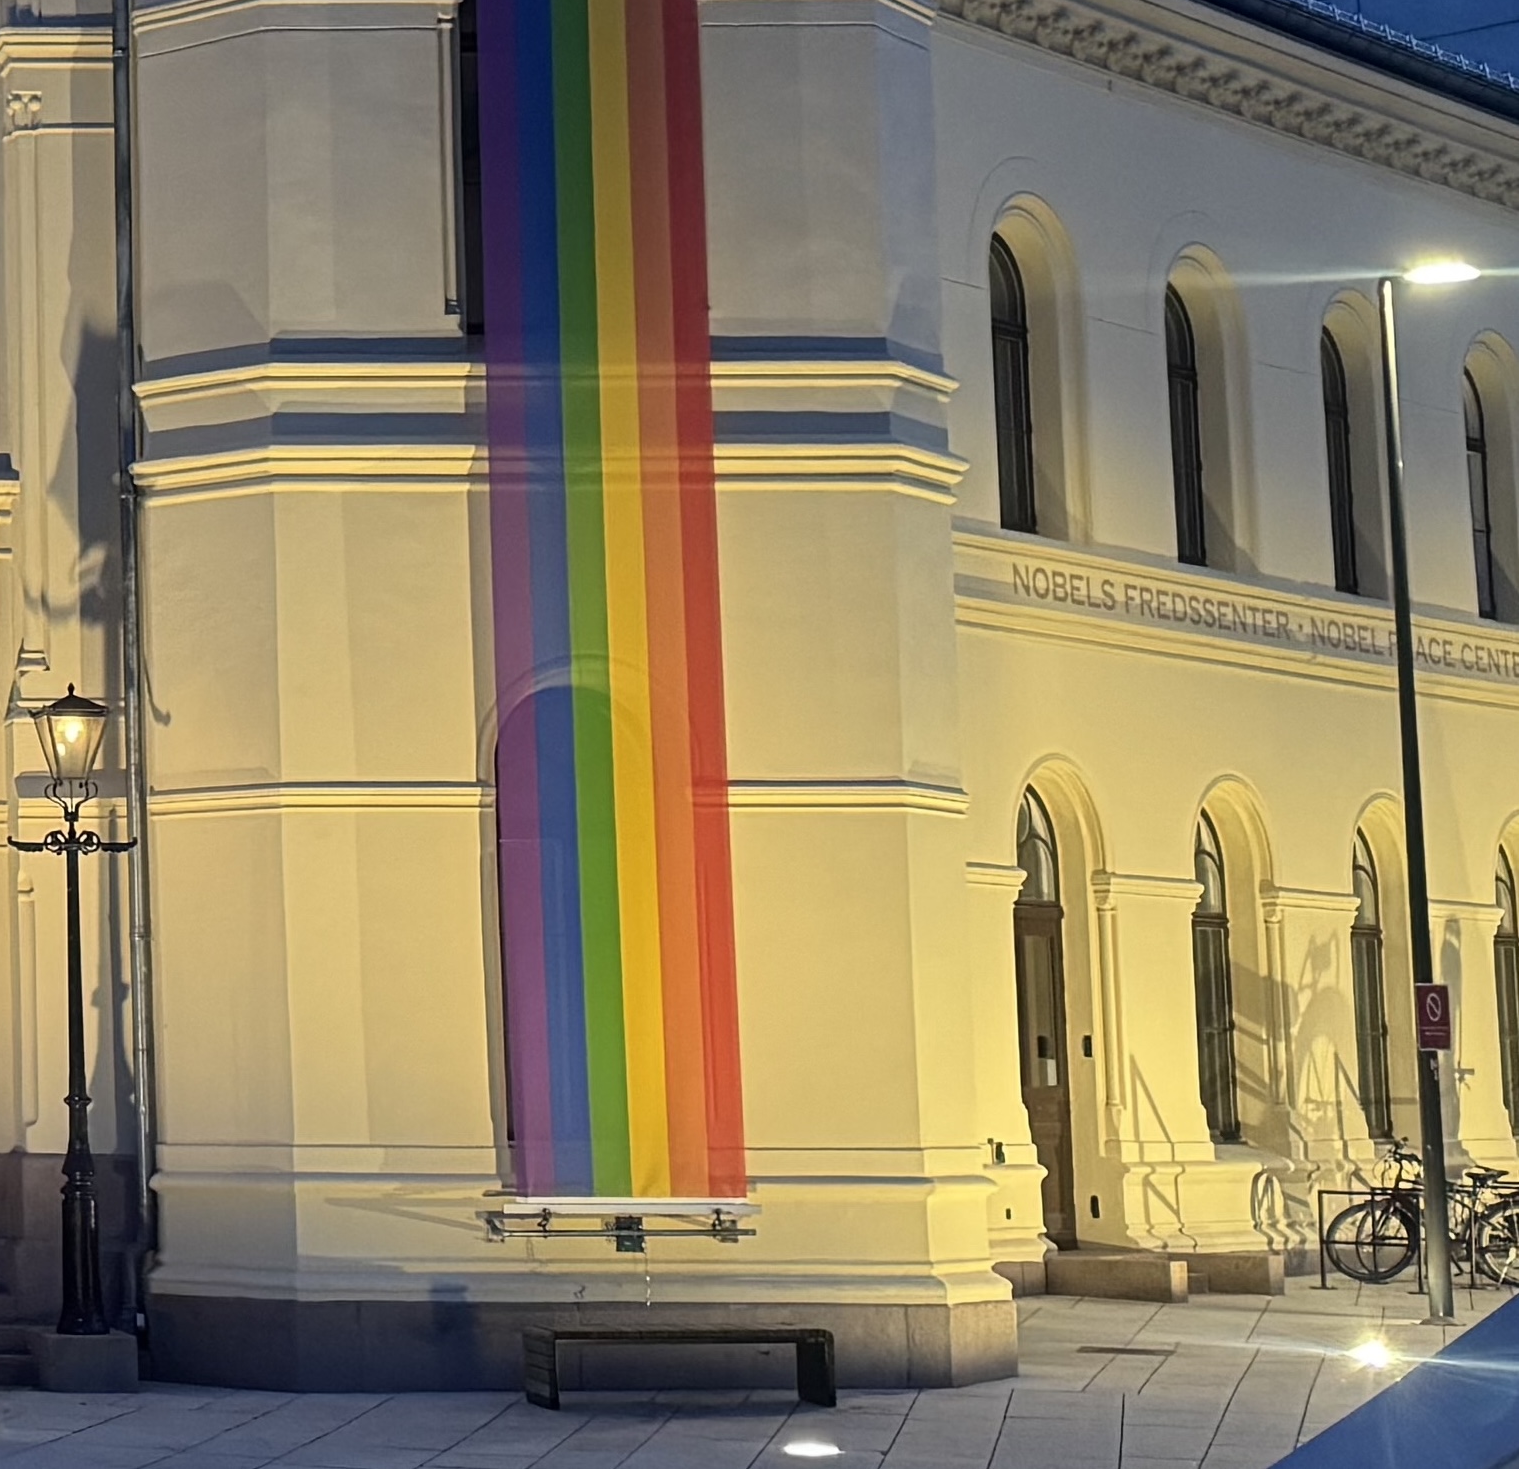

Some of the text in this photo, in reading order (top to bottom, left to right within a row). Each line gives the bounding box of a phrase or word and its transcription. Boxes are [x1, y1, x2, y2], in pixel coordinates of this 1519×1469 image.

[1011, 562, 1116, 611] NOBELS
[1123, 583, 1291, 640] FREDSSENTER
[1310, 616, 1384, 657] NOBEL
[1388, 630, 1455, 668] PACE
